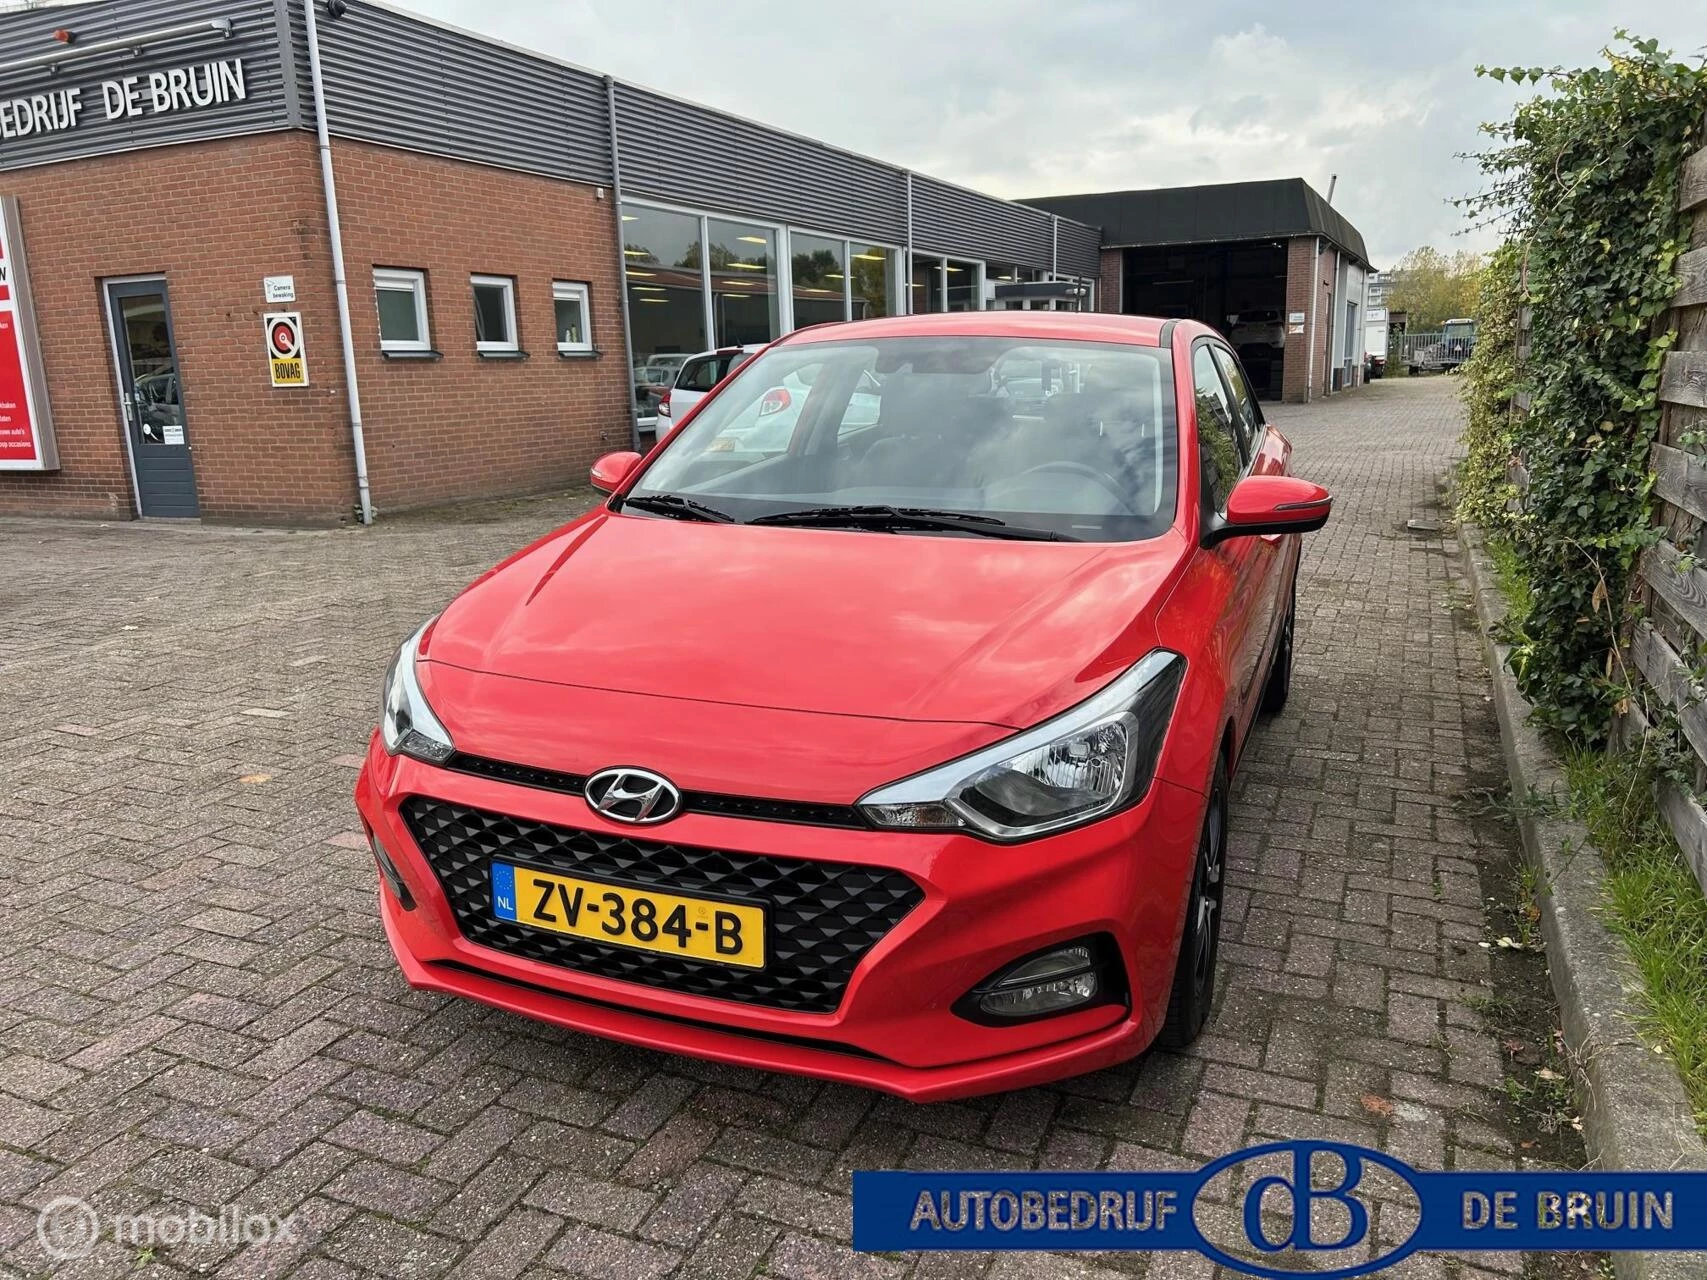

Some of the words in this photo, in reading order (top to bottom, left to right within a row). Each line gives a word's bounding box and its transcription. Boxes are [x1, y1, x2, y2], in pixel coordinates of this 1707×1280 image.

[0, 88, 82, 139] EDRIJF
[101, 76, 143, 120] DE
[149, 58, 247, 113] BRUIN
[274, 362, 301, 380] BOVAG
[497, 895, 514, 911] NL
[532, 878, 744, 956] ZV-384-B
